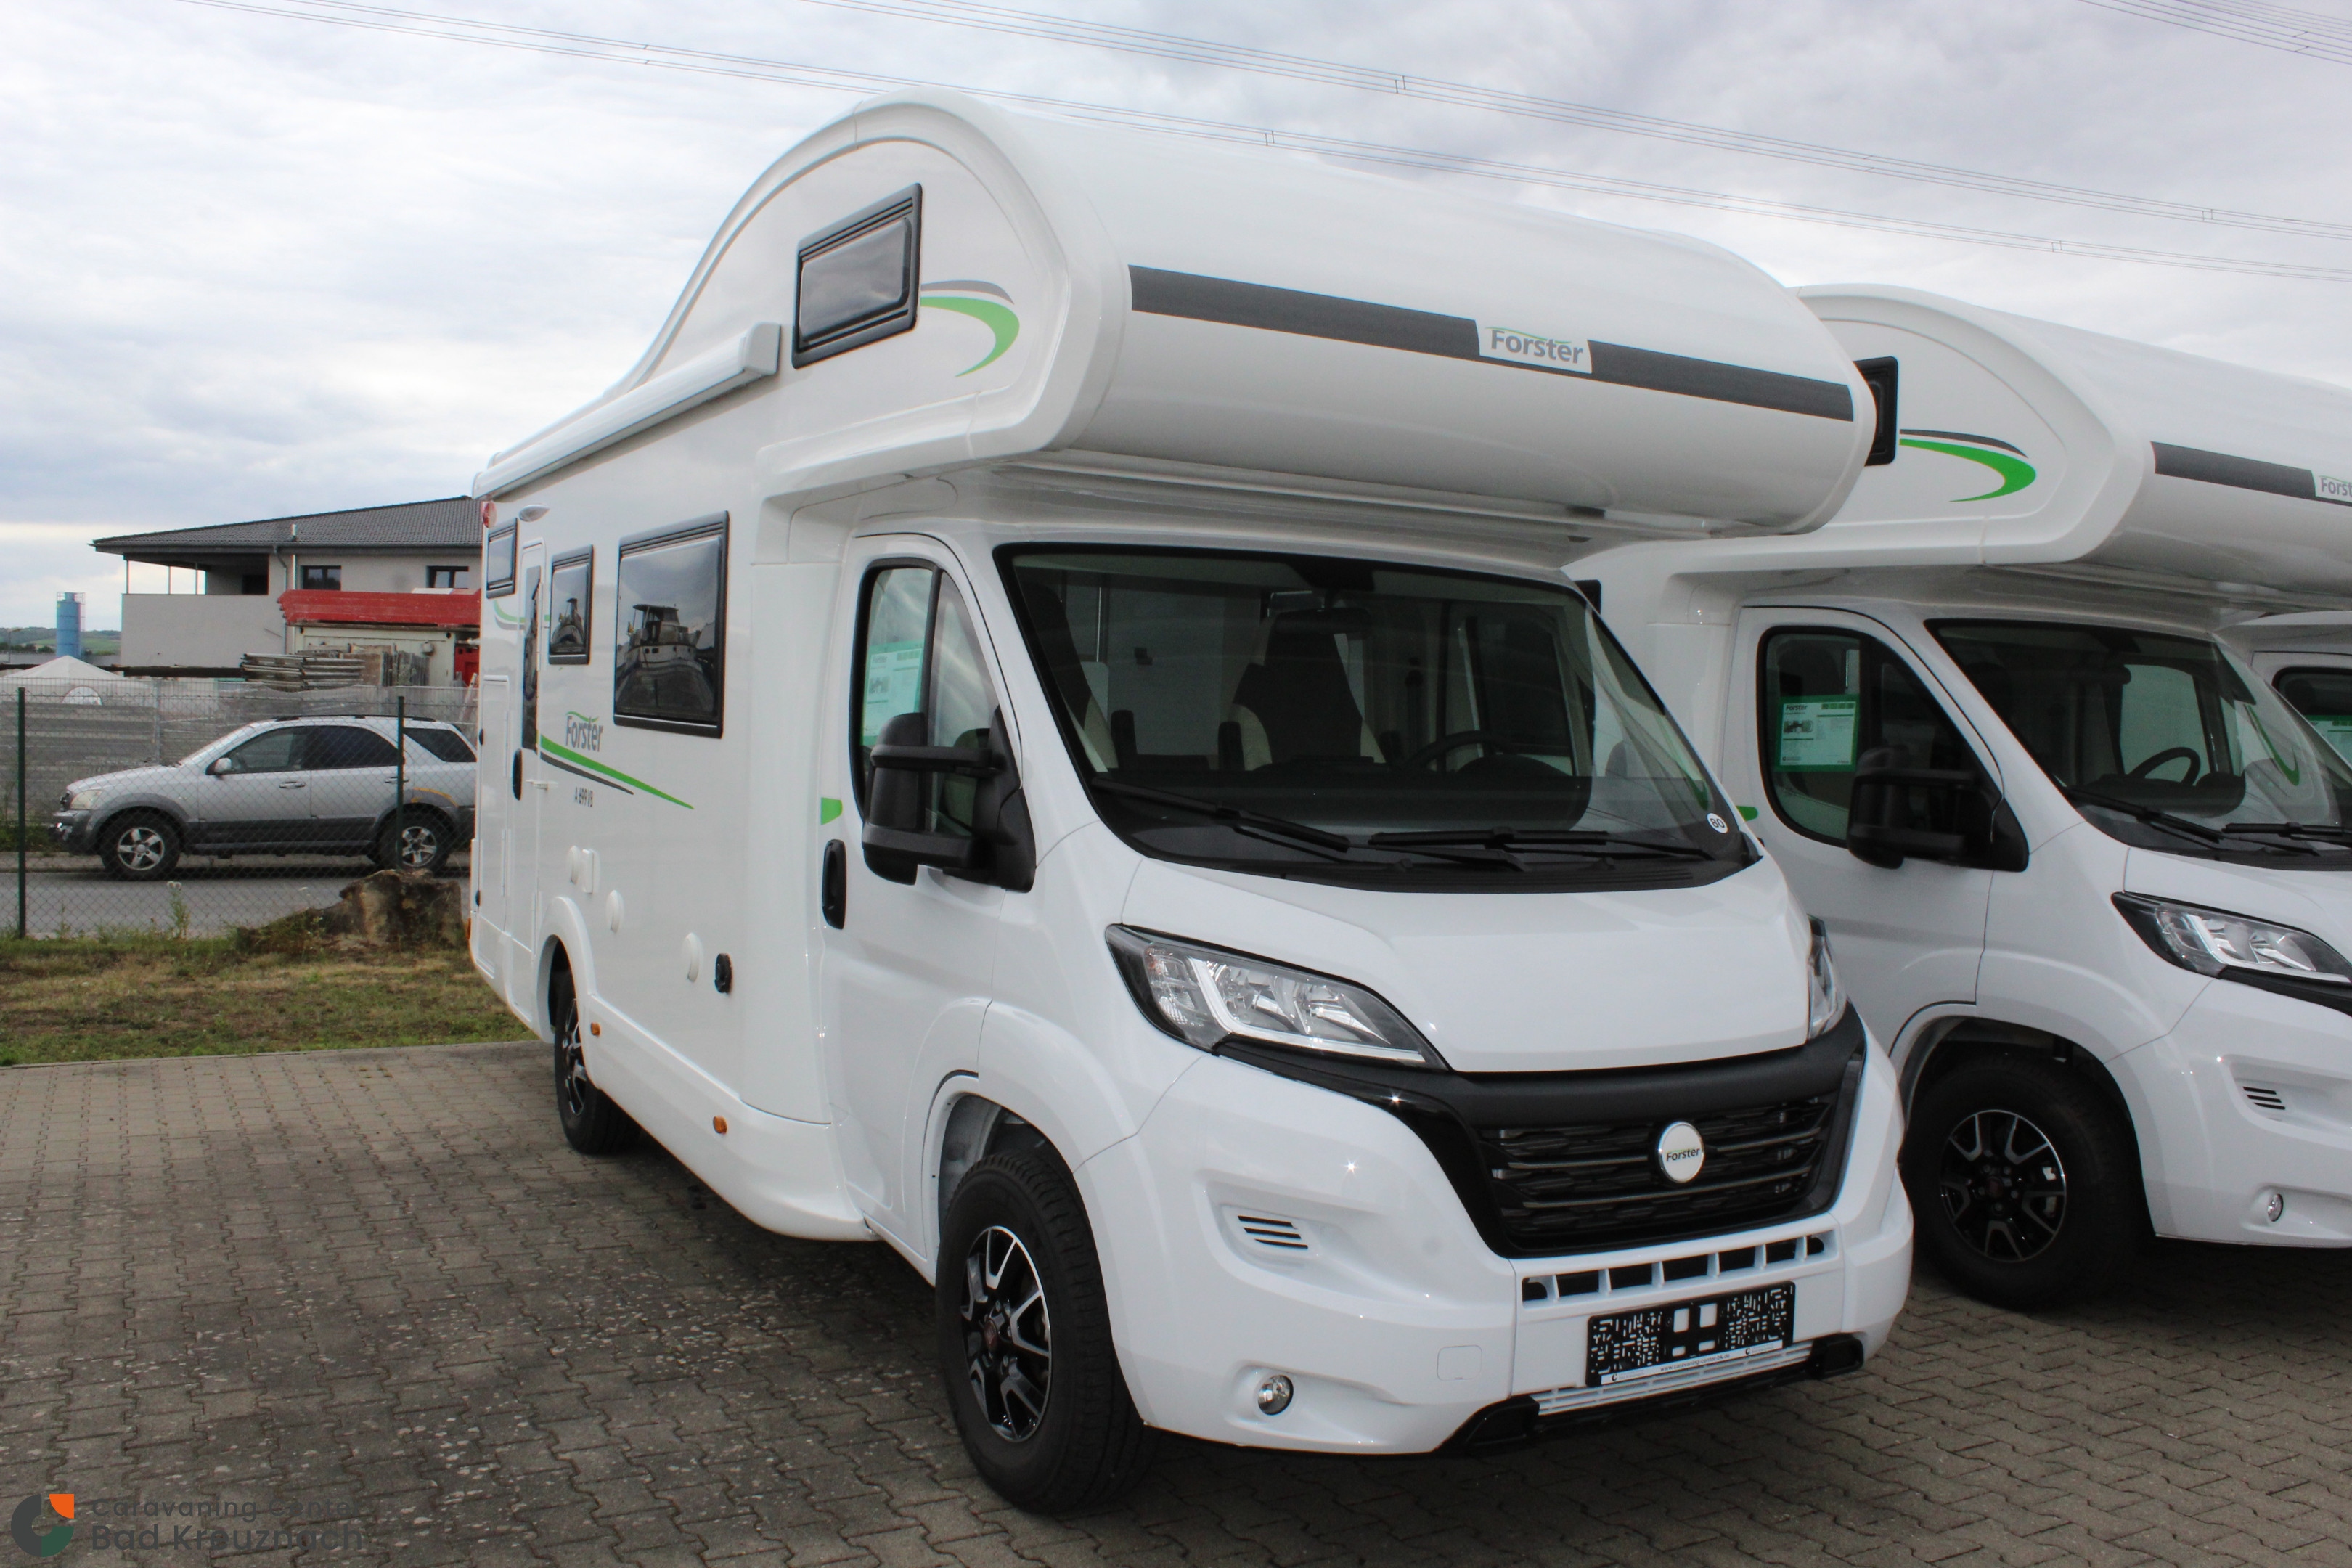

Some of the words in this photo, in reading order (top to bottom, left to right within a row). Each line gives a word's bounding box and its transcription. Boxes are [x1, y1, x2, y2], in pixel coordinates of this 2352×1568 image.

[1490, 329, 1584, 364] Forster
[565, 716, 604, 752] Forster
[1666, 1148, 1701, 1162] Forster
